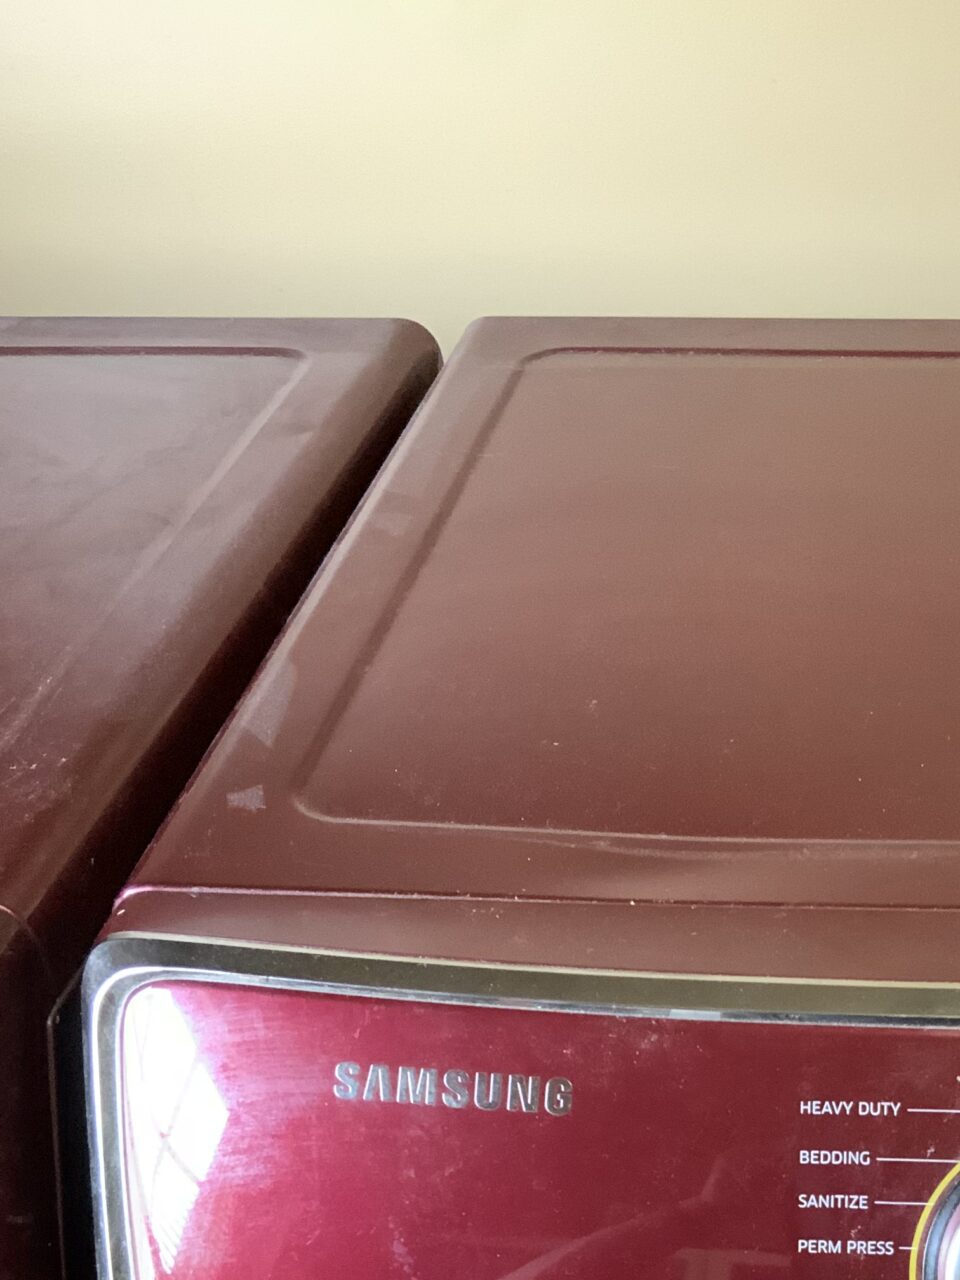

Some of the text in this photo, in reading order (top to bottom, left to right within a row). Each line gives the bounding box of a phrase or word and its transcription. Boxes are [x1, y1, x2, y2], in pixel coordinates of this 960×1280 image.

[332, 1061, 573, 1115] SAMSUNG
[800, 1101, 900, 1117] HEAVY DUTY
[799, 1150, 870, 1166] BEDDING
[798, 1194, 868, 1209] SANITIZE
[798, 1240, 895, 1255] PERM PRESS
